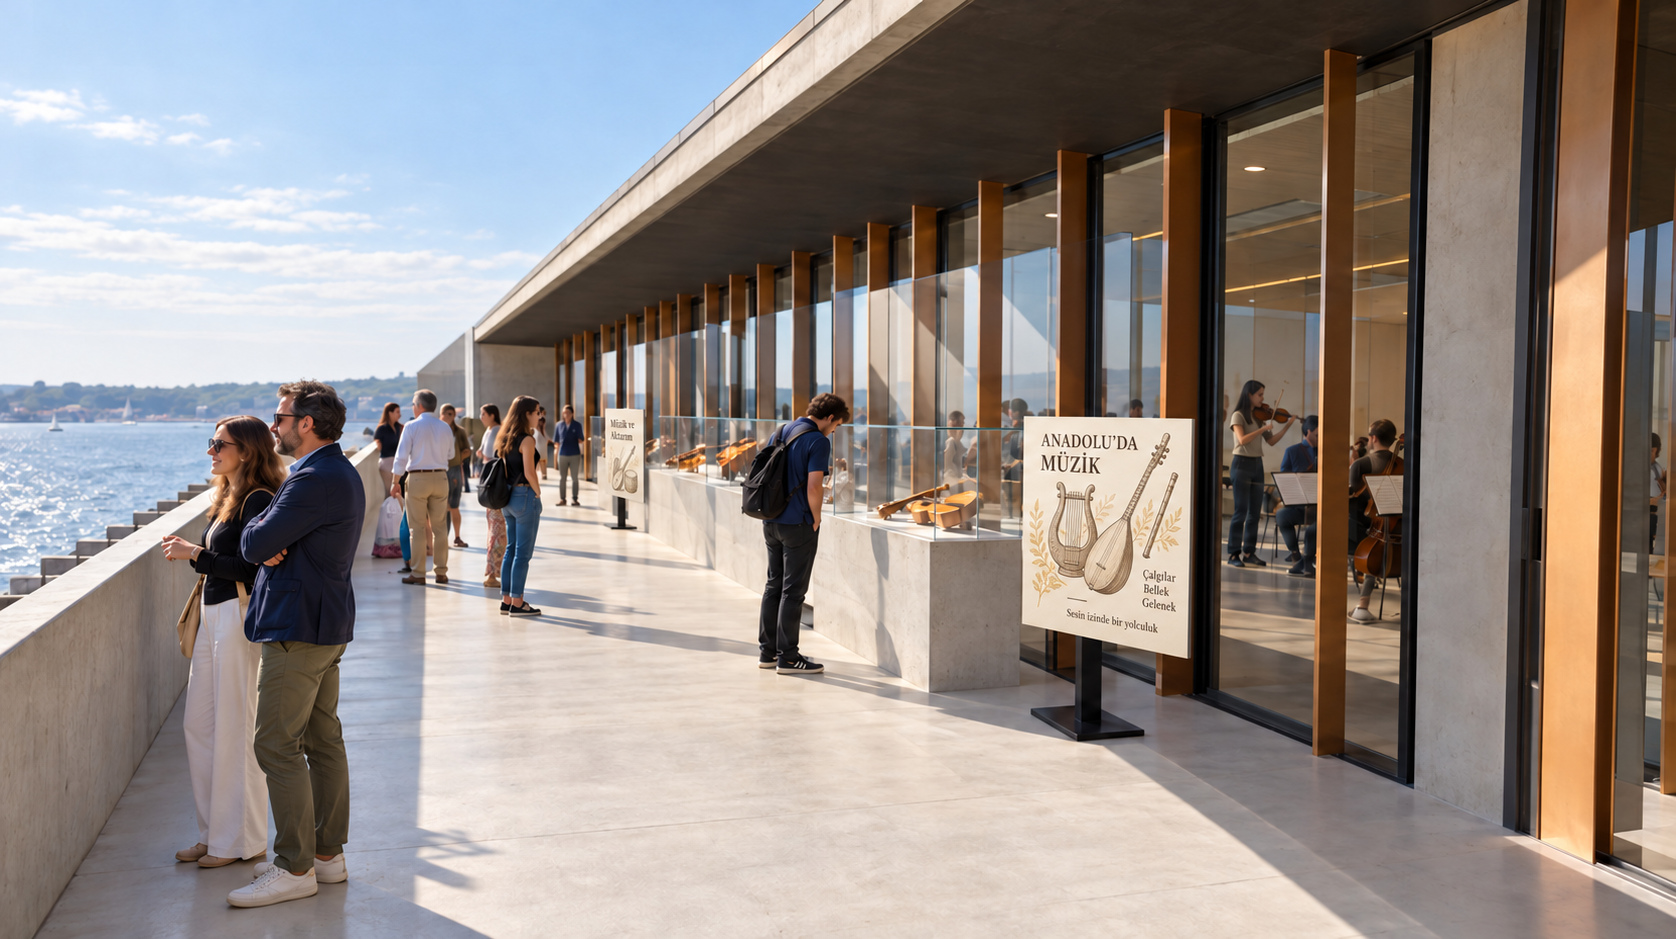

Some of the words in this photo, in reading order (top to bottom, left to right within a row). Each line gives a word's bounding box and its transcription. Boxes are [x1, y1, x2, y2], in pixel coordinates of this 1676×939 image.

[1041, 433, 1139, 451] ANADOLU’DA
[1040, 451, 1101, 475] MÜZİK
[1142, 569, 1177, 583] Çalgılar
[1143, 583, 1170, 597] Bellek
[1142, 597, 1177, 613] Gelenek
[1066, 608, 1086, 620] Sesin
[1087, 611, 1110, 624] izinde
[1111, 615, 1123, 627] bir
[1124, 619, 1159, 634] yolculuk
